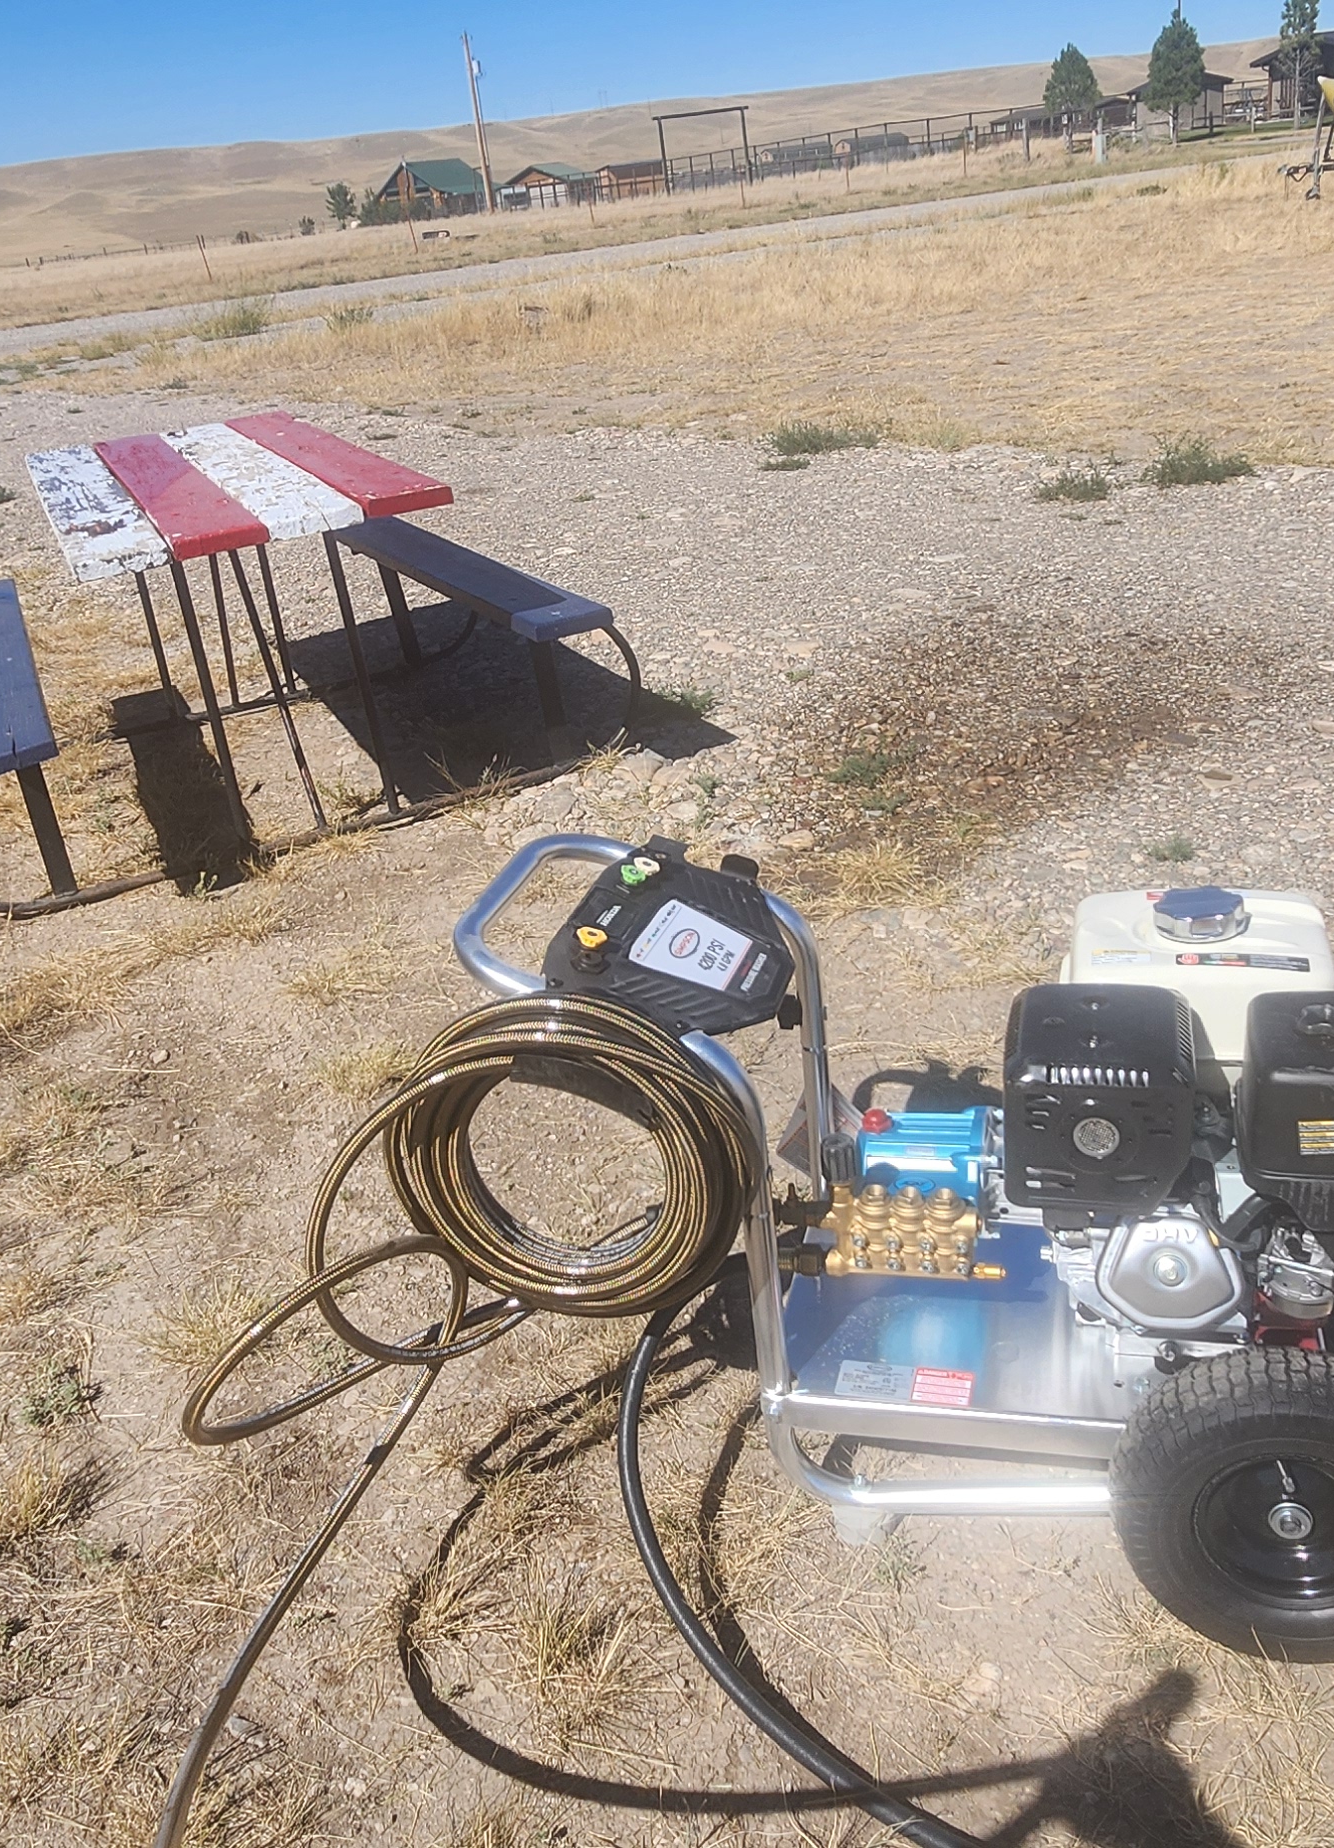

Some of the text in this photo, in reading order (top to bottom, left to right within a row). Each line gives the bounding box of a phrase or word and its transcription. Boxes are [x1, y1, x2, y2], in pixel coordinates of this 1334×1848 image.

[673, 931, 695, 955] SIMPSON
[697, 938, 726, 971] 4200 PSI
[721, 949, 736, 965] GPM
